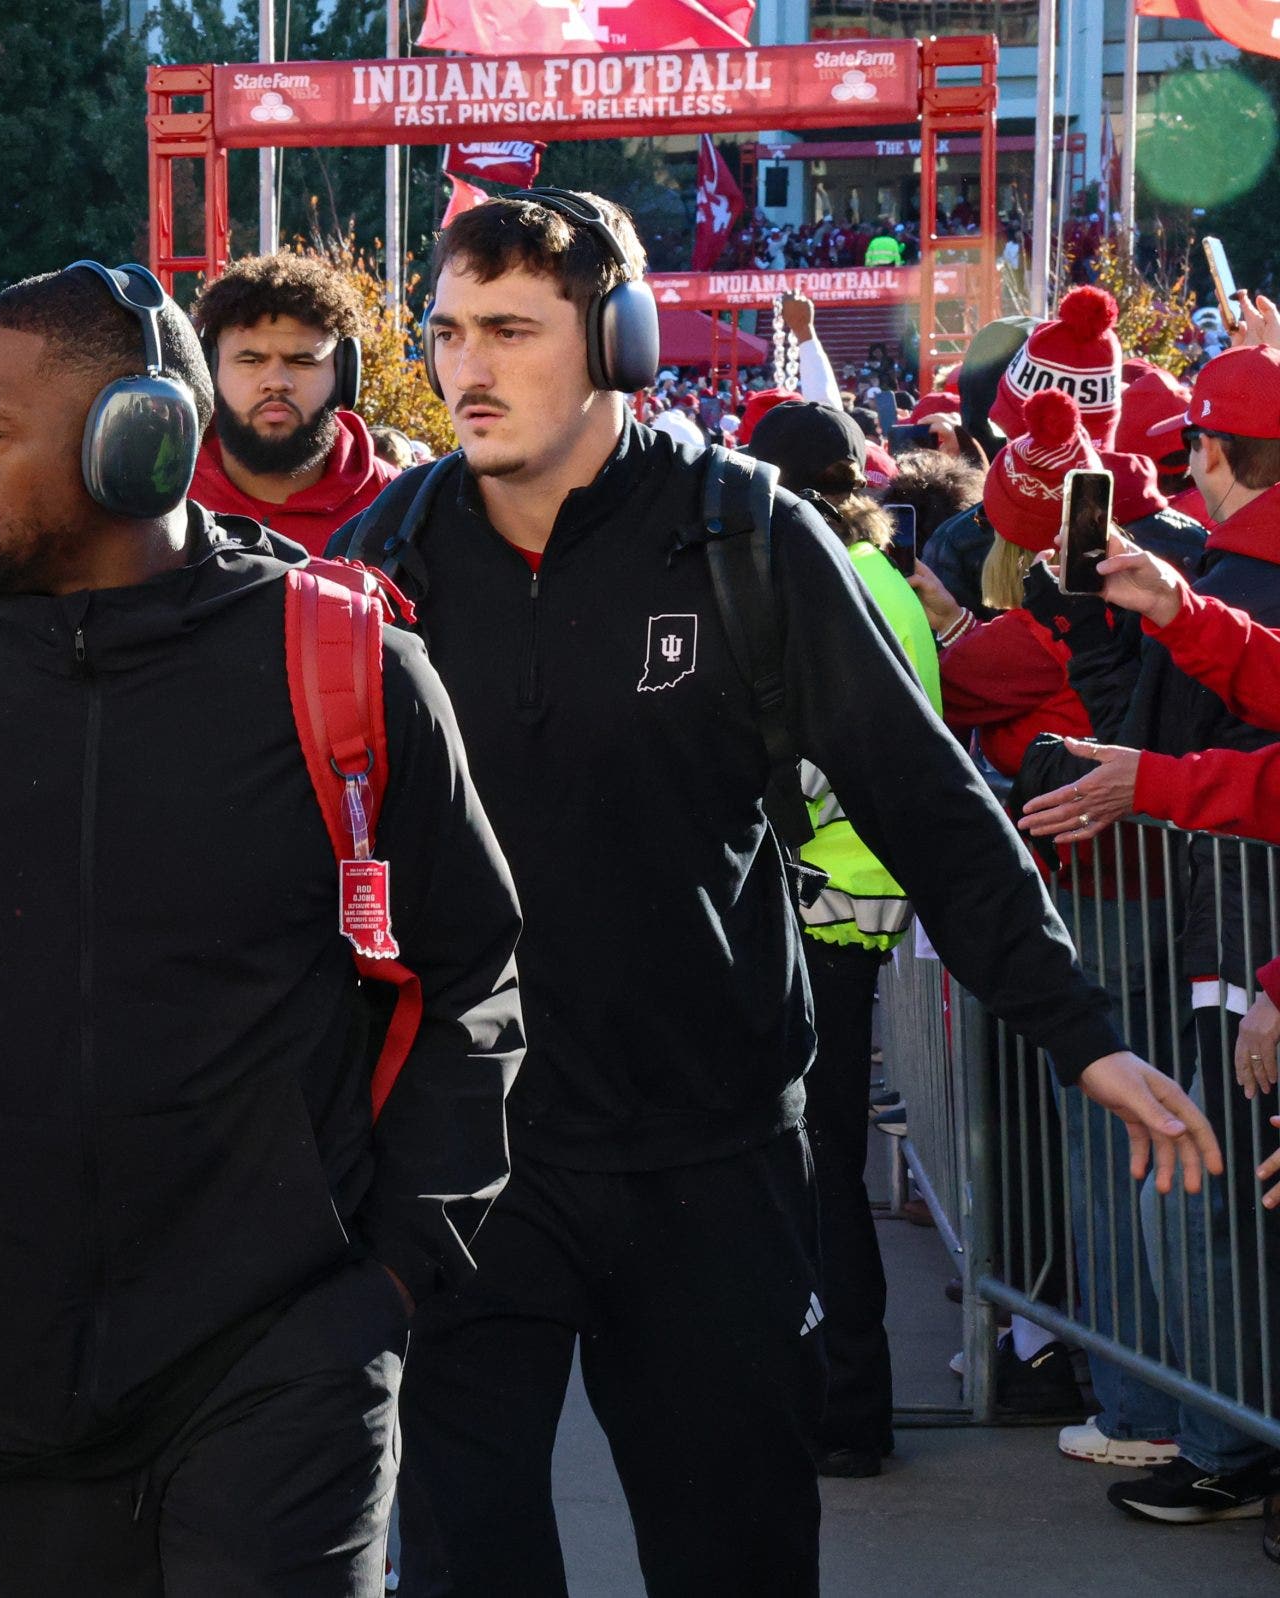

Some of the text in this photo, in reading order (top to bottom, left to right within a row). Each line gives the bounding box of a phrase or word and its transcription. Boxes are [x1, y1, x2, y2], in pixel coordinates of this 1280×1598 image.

[352, 52, 771, 104] INDIANA FOOTBALL
[394, 94, 733, 126] FAST. PHYSICAL. RELENTLESS.
[875, 140, 904, 155] THE
[709, 271, 899, 294] INDIANA FOOTBALL
[356, 885, 372, 893] ROD
